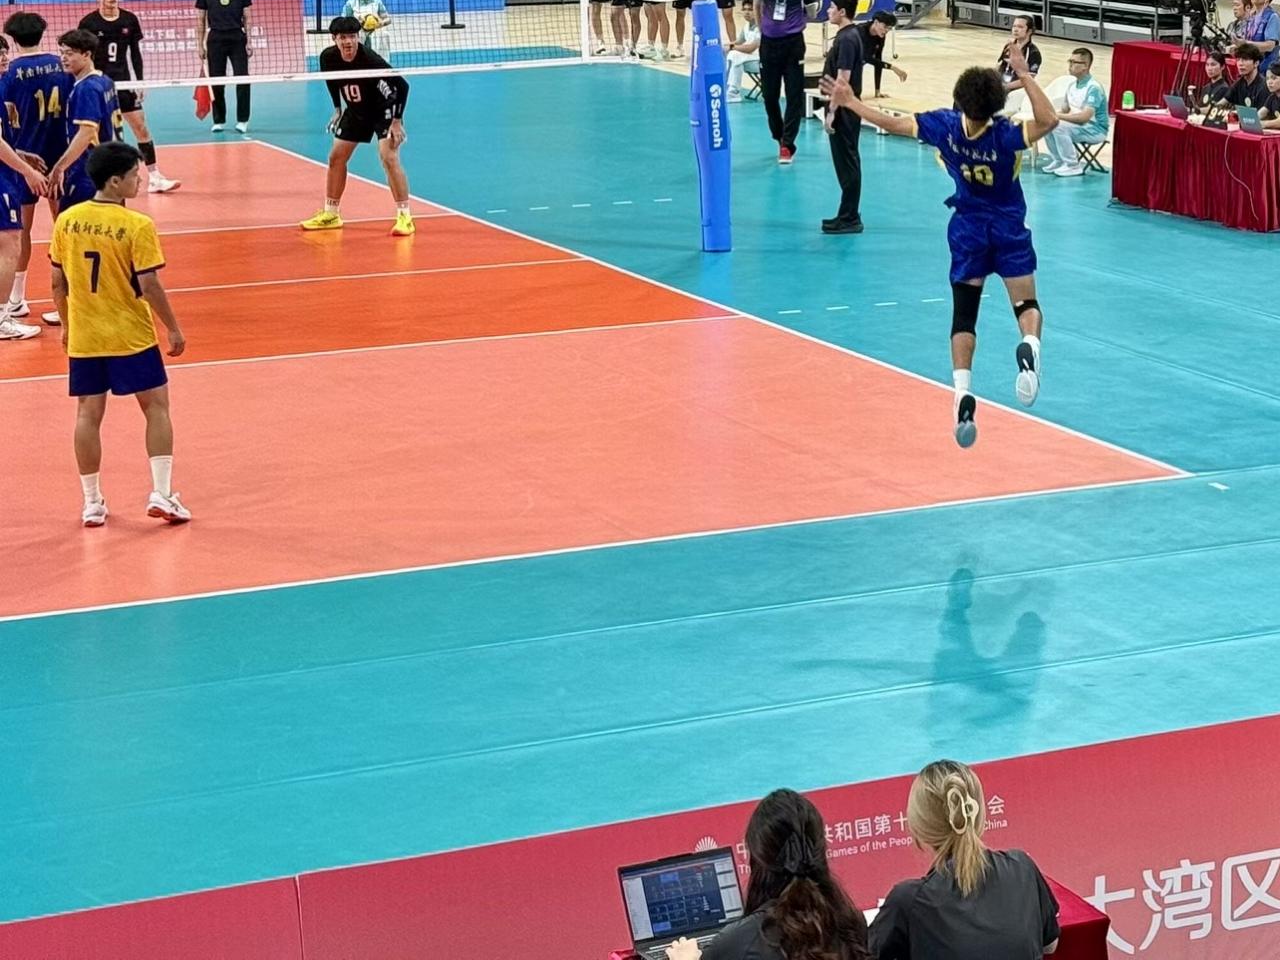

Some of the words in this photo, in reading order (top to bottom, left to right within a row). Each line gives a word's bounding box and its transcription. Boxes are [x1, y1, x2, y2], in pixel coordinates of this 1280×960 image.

[107, 42, 118, 62] 9
[34, 85, 61, 122] 14
[710, 99, 724, 148] Senoh
[84, 251, 101, 294] 7
[860, 841, 870, 853] of
[872, 840, 887, 850] the
